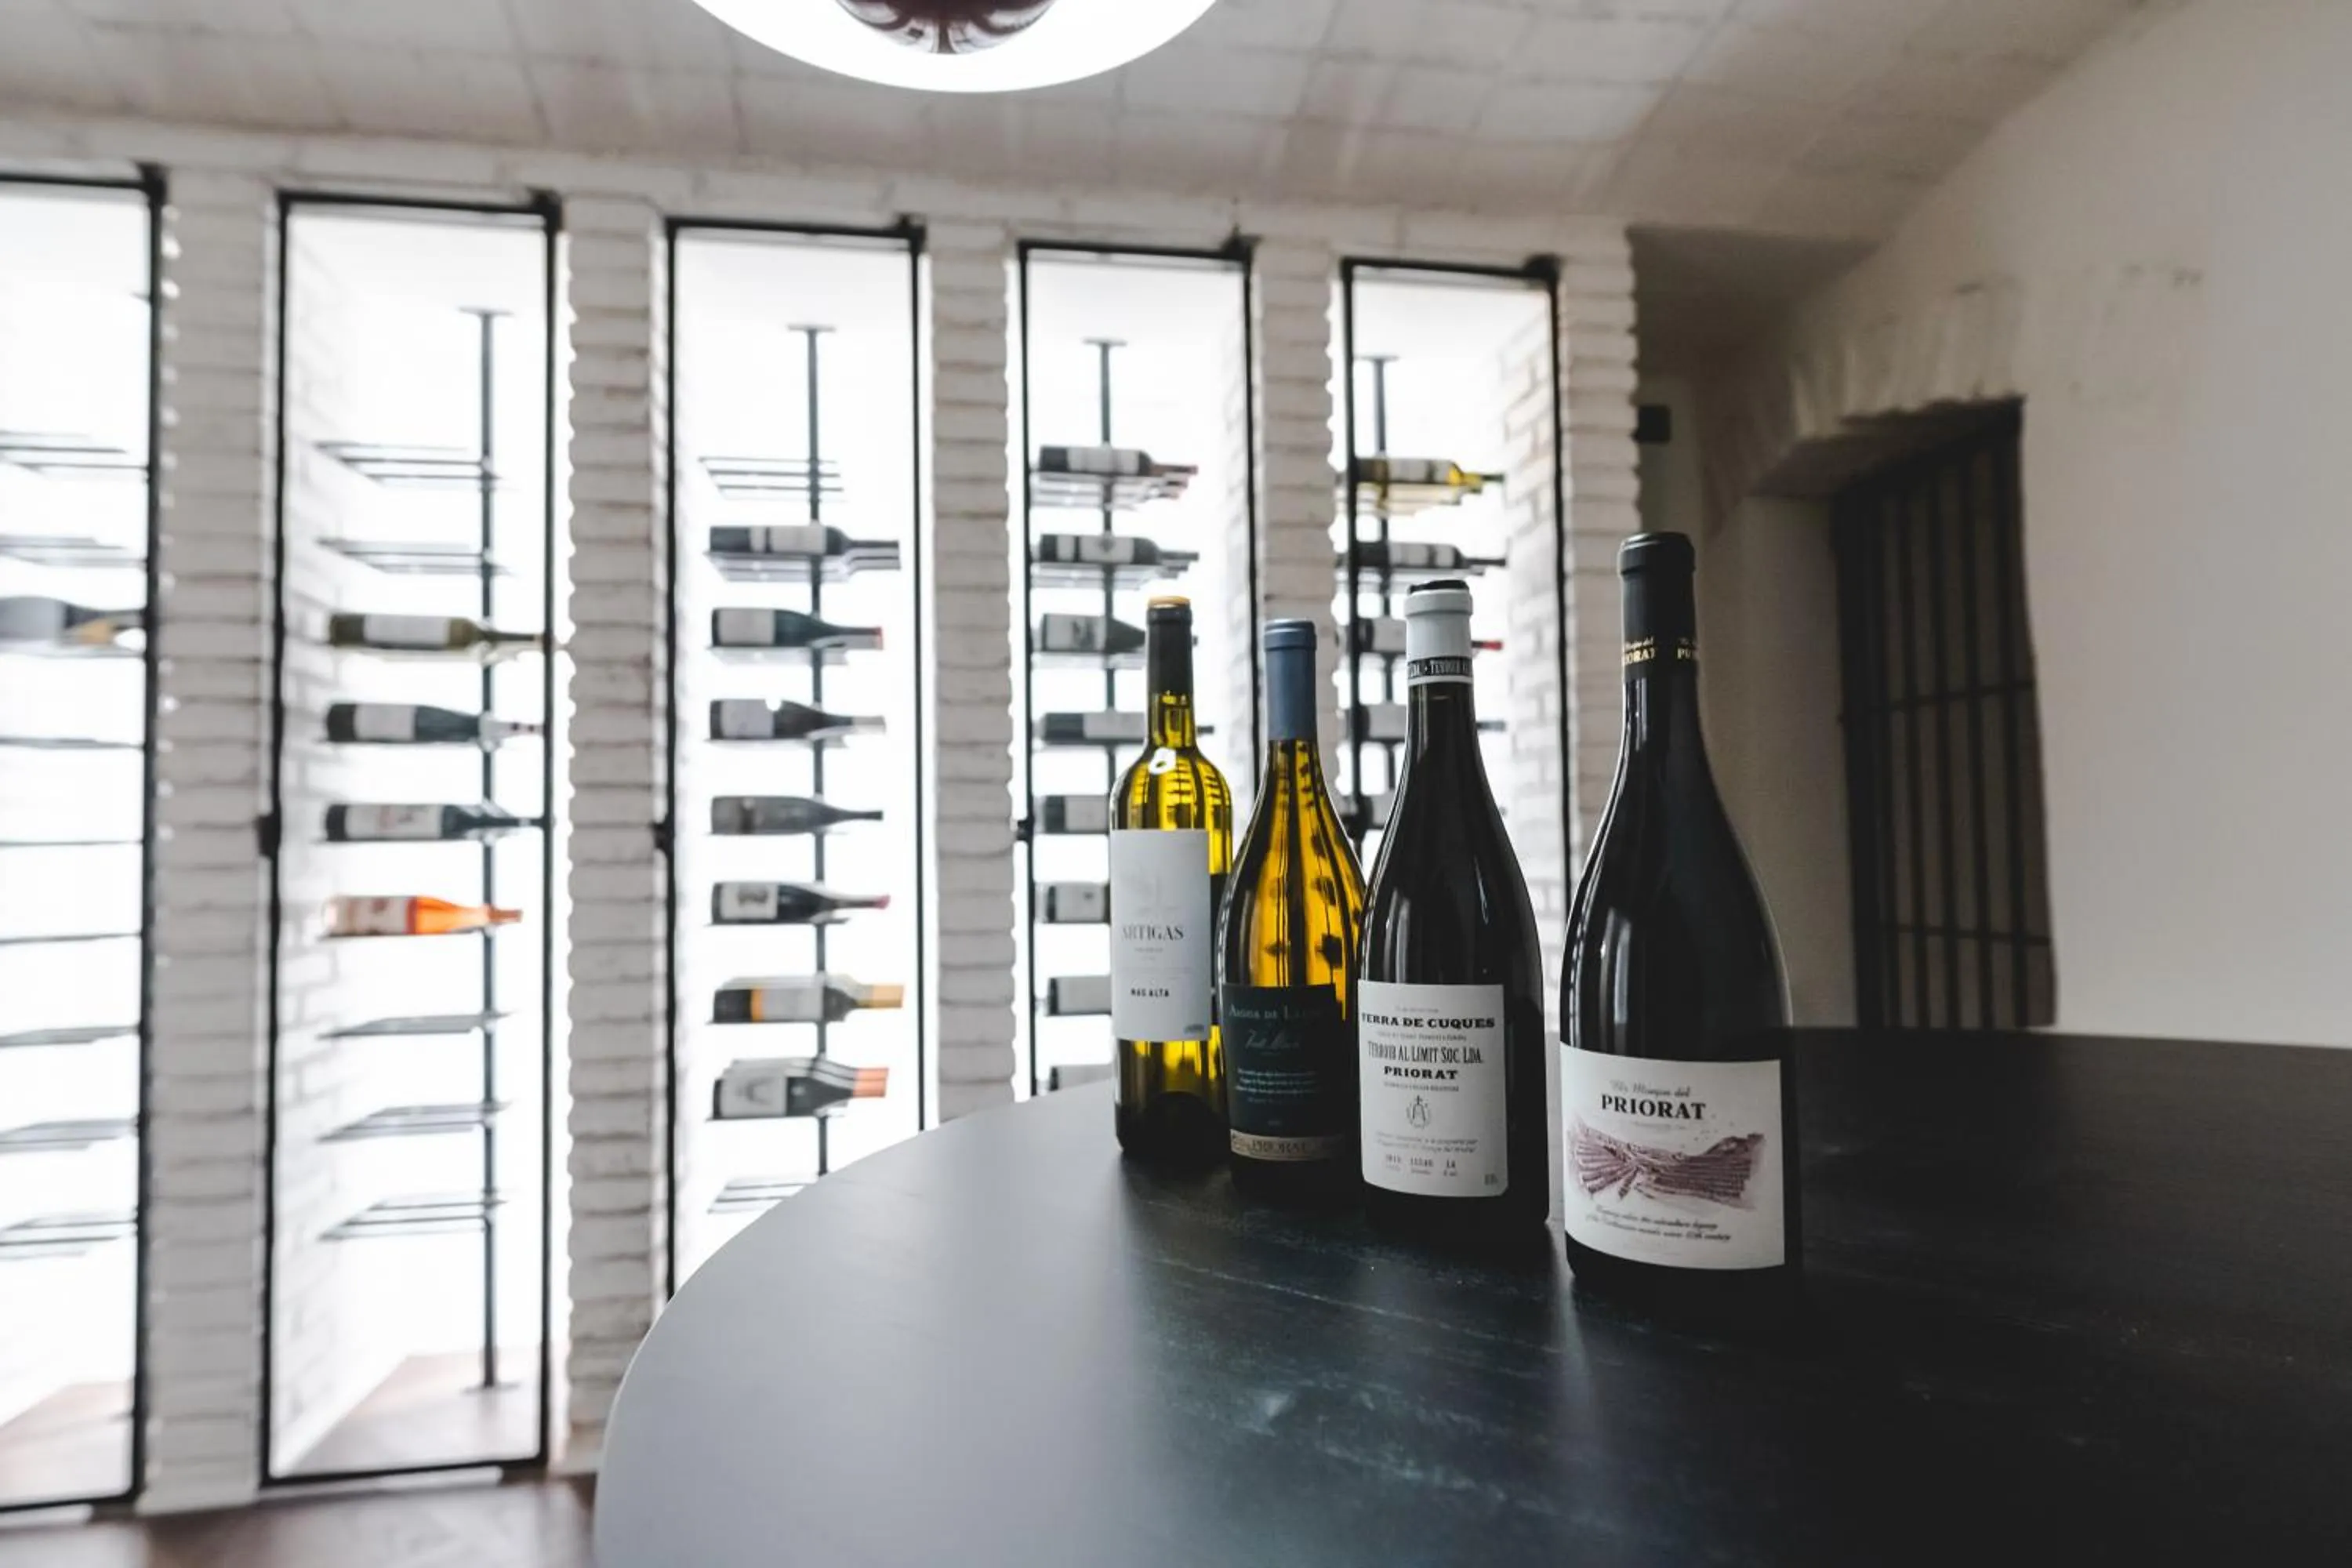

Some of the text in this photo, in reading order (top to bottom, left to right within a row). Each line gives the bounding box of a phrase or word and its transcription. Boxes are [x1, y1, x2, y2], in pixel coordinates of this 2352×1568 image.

[1121, 924, 1185, 942] ARTIGAS
[1362, 1012, 1496, 1030] TERRA DE CUQUES
[1398, 1045, 1410, 1062] AL
[1411, 1045, 1438, 1064] LIMIT
[1383, 1065, 1459, 1080] PRIORAT
[1601, 1093, 1707, 1121] PRIORAT
